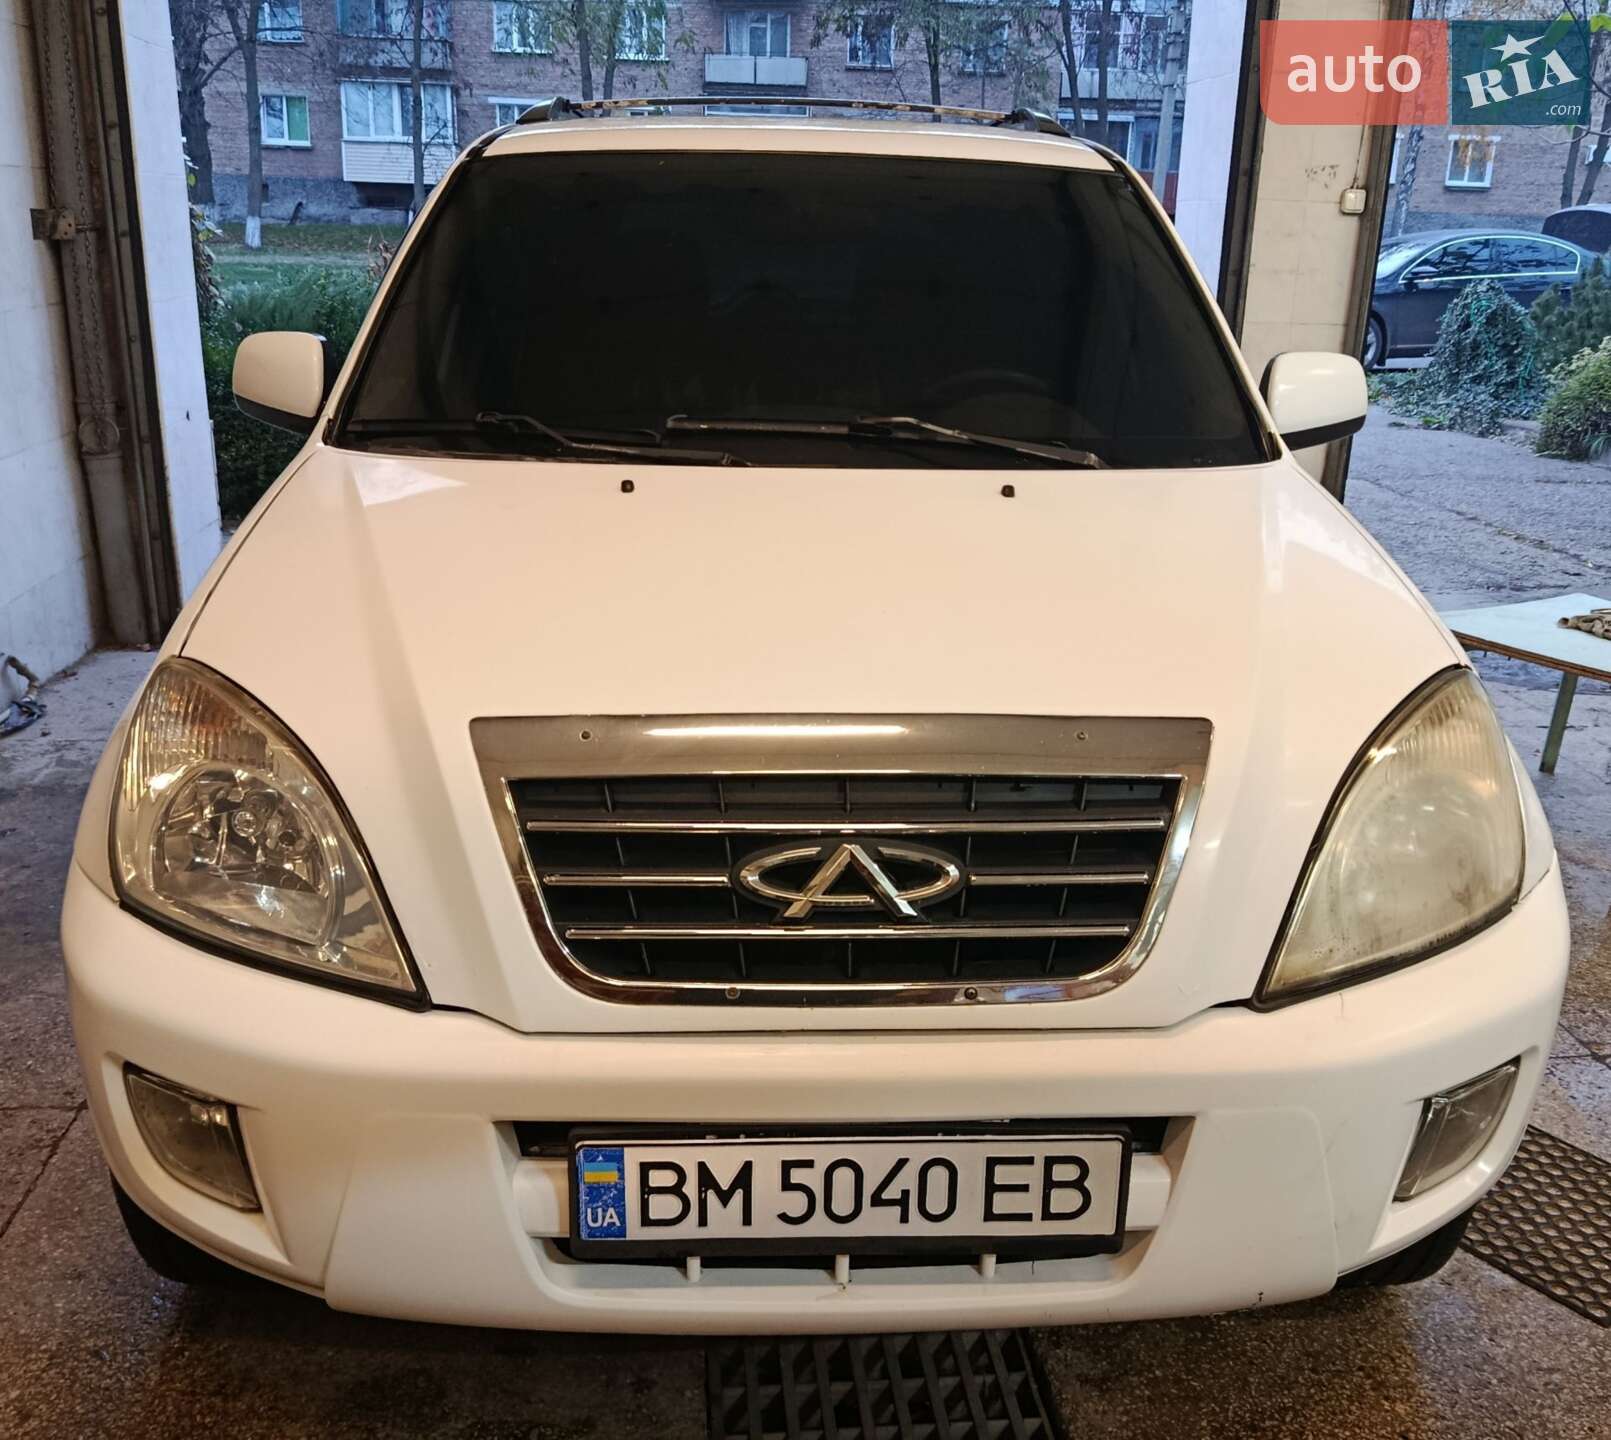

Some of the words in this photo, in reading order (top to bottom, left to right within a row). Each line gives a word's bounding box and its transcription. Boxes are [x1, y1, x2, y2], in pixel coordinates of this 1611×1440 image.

[638, 1160, 753, 1228] BM
[776, 1157, 958, 1225] 5040
[982, 1155, 1093, 1223] EB
[586, 1206, 621, 1229] UA
